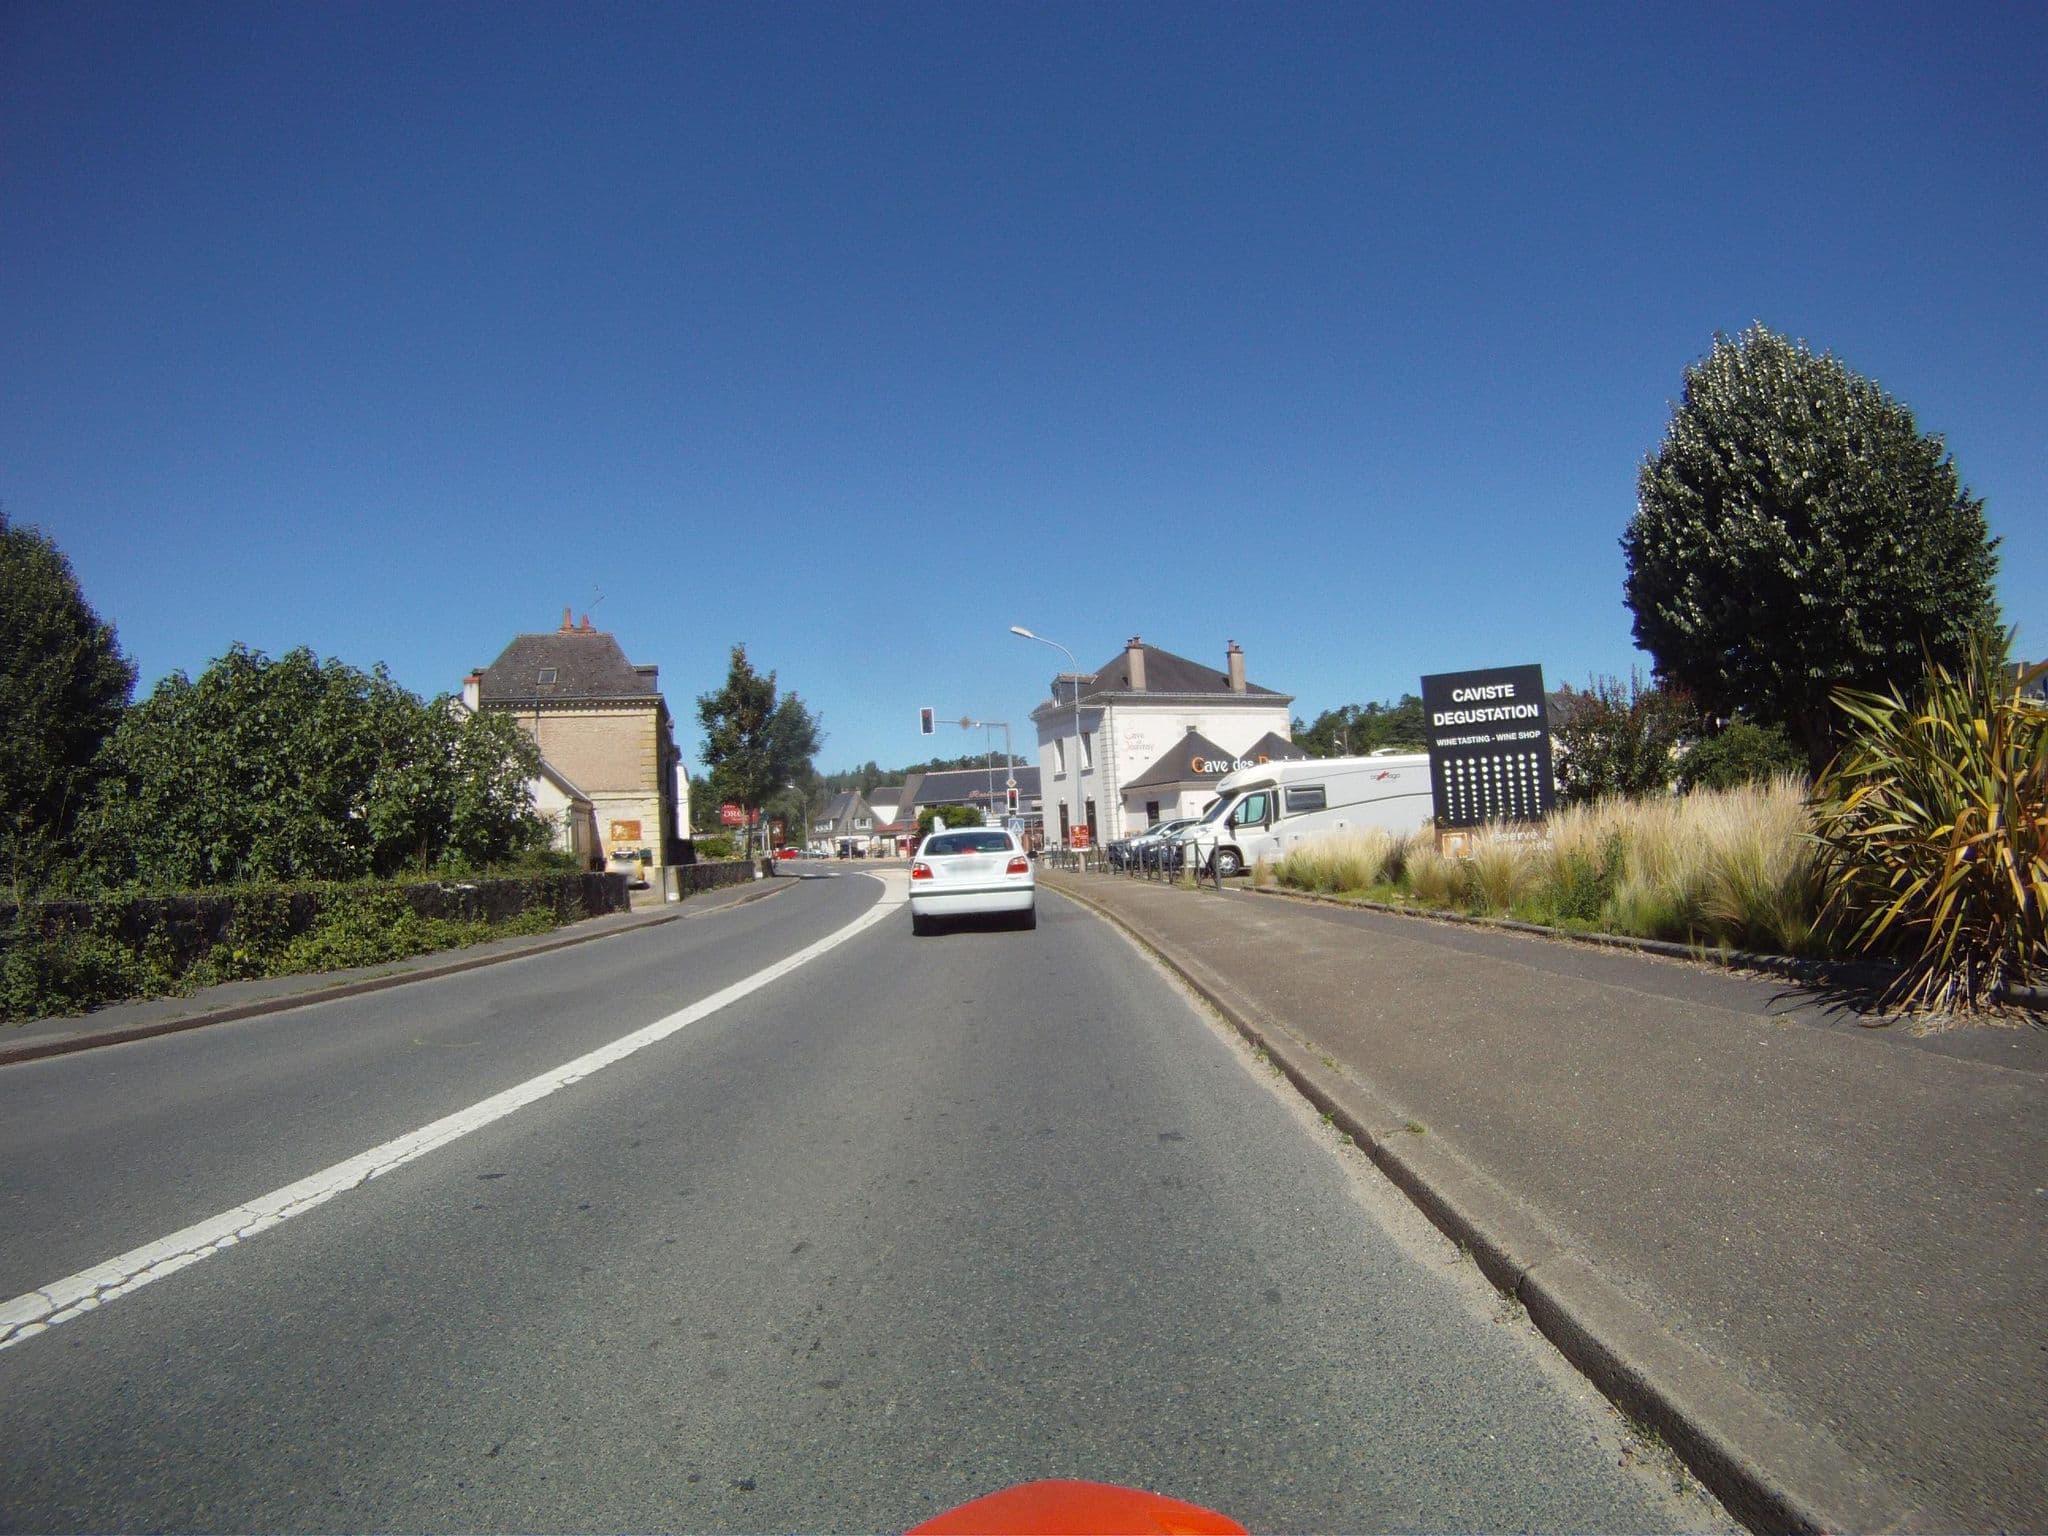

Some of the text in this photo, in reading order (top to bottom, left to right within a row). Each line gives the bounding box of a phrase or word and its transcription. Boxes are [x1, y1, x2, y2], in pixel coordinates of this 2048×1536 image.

[1452, 684, 1515, 702] CAVISTE
[1433, 703, 1539, 726] DEGUSTATION
[1496, 732, 1517, 742] WINE
[1518, 730, 1541, 740] SHOP
[1192, 756, 1228, 774] Cave
[1232, 756, 1254, 771] des
